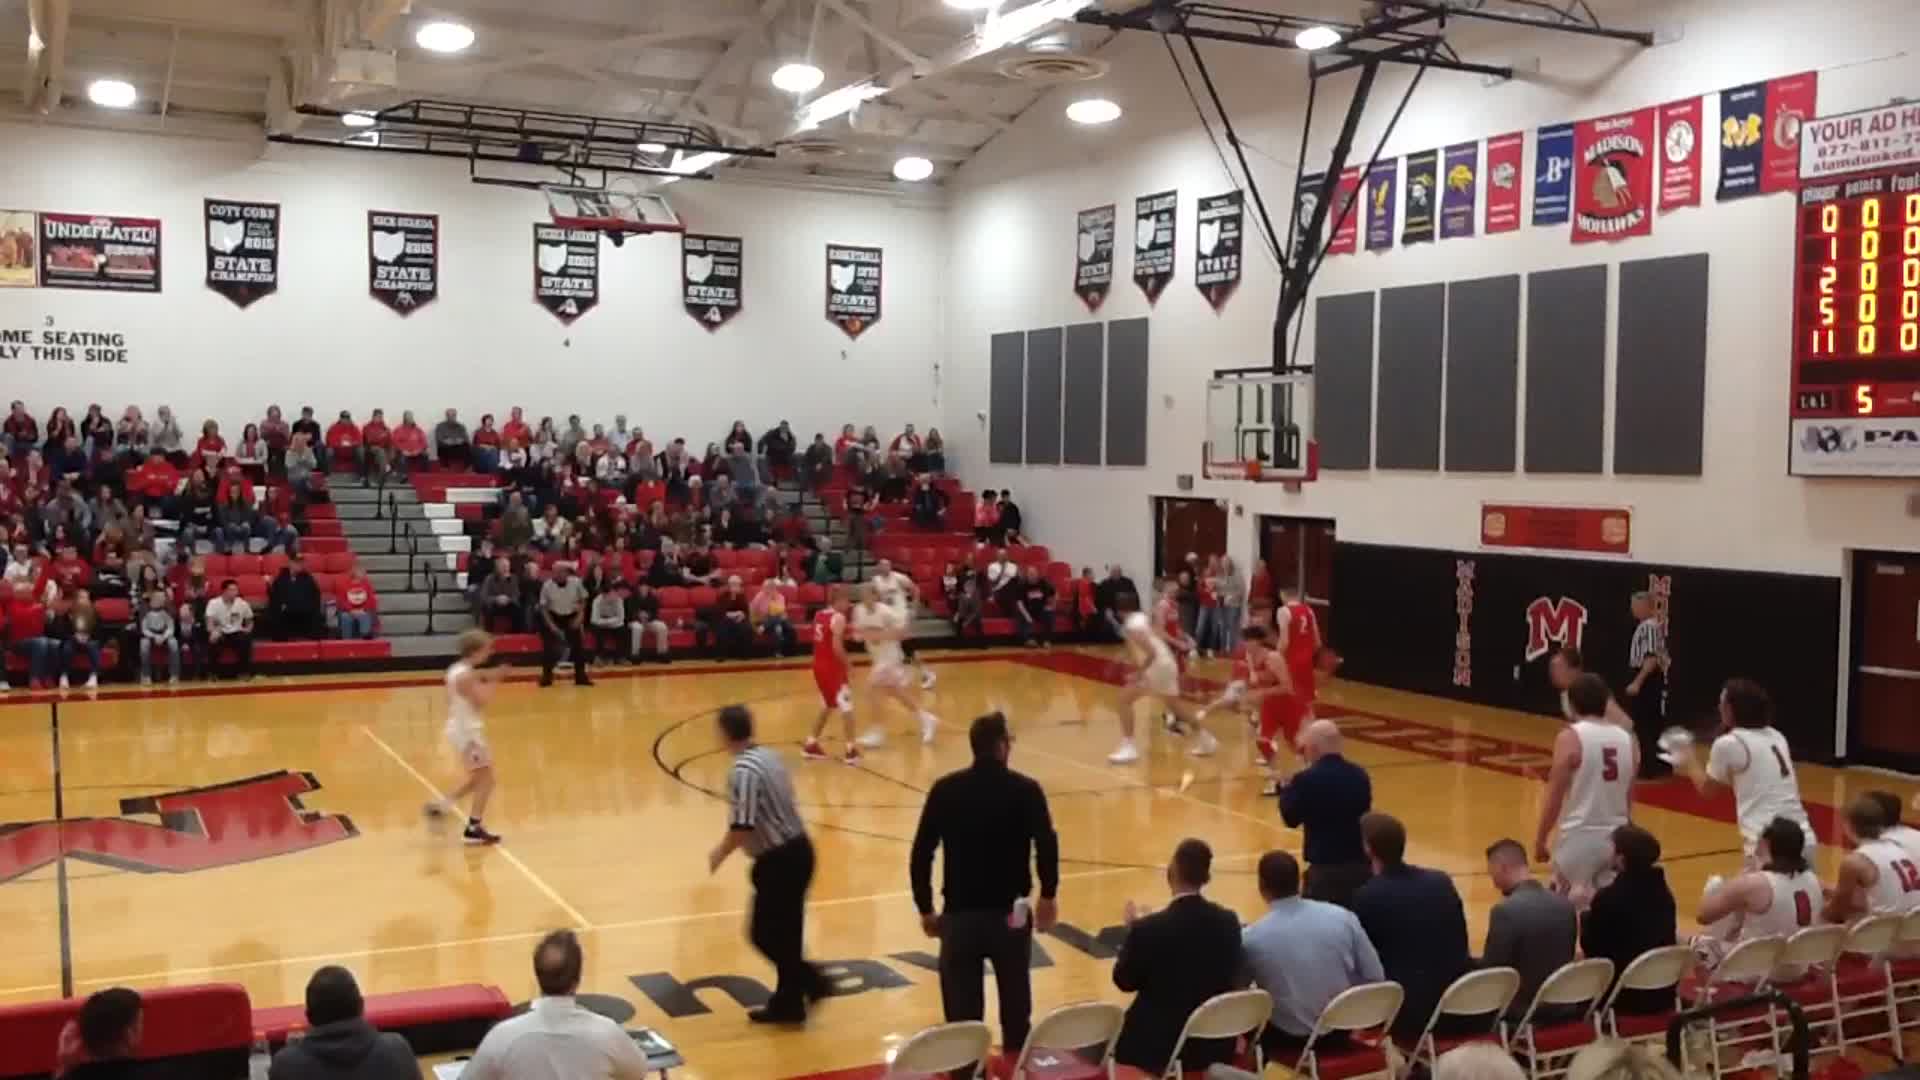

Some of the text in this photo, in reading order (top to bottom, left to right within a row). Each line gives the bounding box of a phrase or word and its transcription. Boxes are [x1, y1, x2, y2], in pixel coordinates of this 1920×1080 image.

[1810, 117, 1863, 144] YOUR
[1869, 111, 1897, 134] AD
[1584, 134, 1644, 164] MADISON
[1577, 207, 1645, 233] MOHAWKS
[1822, 194, 1920, 233] 0 0 0
[1831, 226, 1920, 260] 1 0 0
[210, 270, 275, 283] CHAMPION
[214, 255, 273, 273] STATE
[376, 265, 432, 281] STATE
[1200, 255, 1237, 273] STATE
[1819, 258, 1920, 294] 2 0 0
[542, 276, 593, 289] STATE
[688, 285, 736, 298] STATE
[831, 293, 877, 306] STATE
[1819, 290, 1918, 326] 5 0 0
[0, 330, 125, 347] ME SEATING
[1813, 322, 1918, 354] 11 0 0
[31, 346, 75, 361] THIS
[85, 349, 128, 363] SIDE
[1857, 385, 1873, 413] 5
[1525, 596, 1588, 662] M
[1602, 748, 1618, 782] 5
[1771, 745, 1790, 777] 1
[1890, 859, 1920, 893] 12
